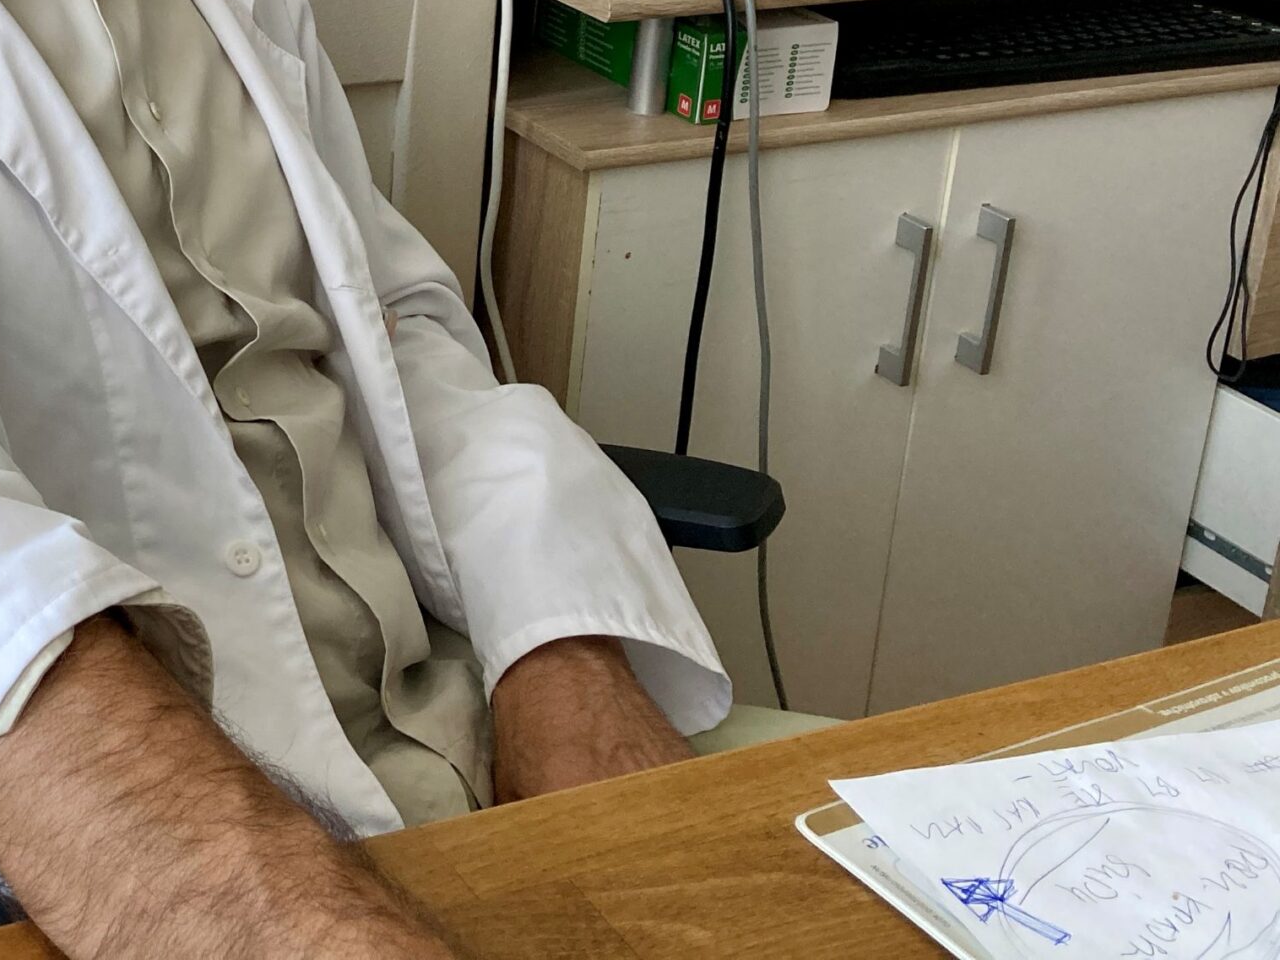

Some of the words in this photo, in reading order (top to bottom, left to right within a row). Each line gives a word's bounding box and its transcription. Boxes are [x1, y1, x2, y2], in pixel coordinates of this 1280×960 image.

[678, 31, 700, 49] LATEX
[710, 43, 725, 53] LAT
[681, 99, 689, 111] M
[707, 104, 717, 114] M
